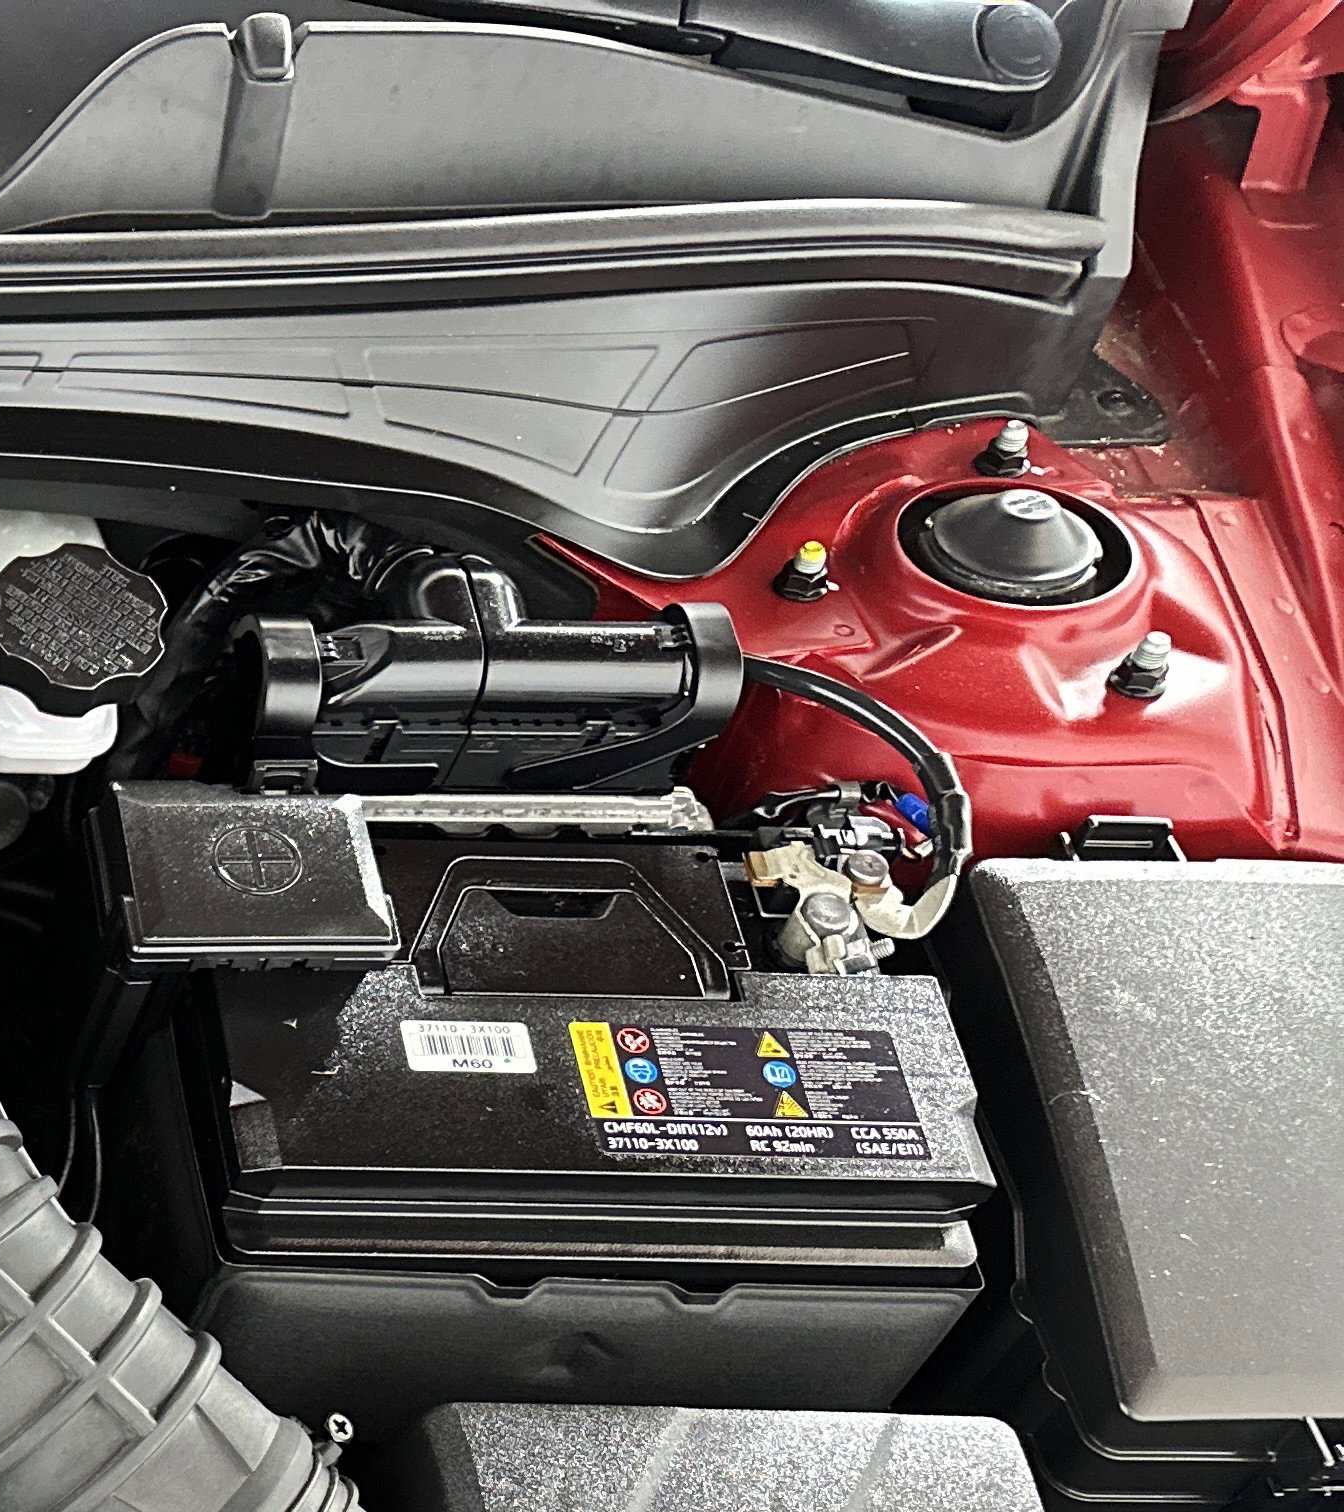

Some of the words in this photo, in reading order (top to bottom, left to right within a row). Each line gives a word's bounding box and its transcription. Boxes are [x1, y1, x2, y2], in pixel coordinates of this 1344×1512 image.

[452, 1058, 493, 1069] M60
[850, 1127, 881, 1140] CCA
[606, 1135, 700, 1152] 37110-3X100
[749, 1139, 771, 1152] RC
